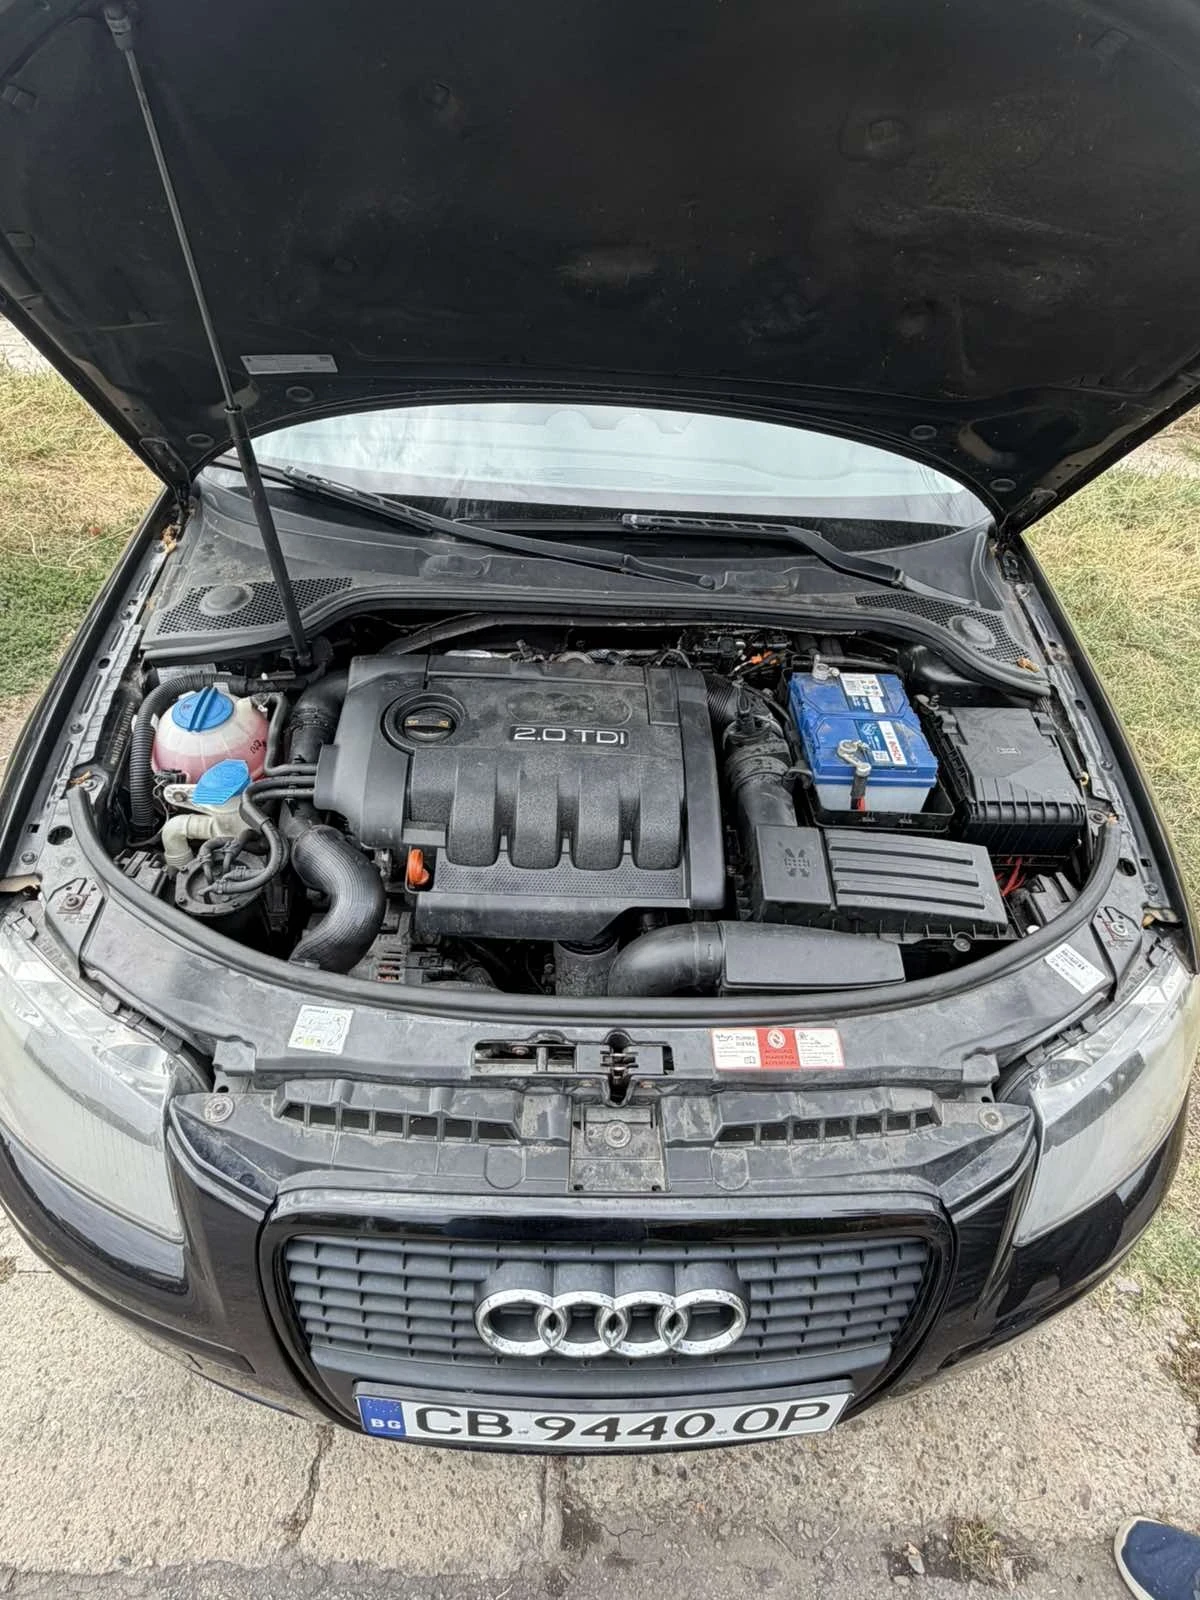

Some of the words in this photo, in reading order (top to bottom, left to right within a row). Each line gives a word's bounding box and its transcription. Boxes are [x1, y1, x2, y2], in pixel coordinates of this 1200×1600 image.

[514, 727, 566, 741] 2.0
[573, 729, 625, 745] TDI
[371, 1418, 401, 1429] BG
[415, 1407, 513, 1438] CB
[534, 1412, 716, 1442] 9440
[732, 1402, 830, 1434] OP
